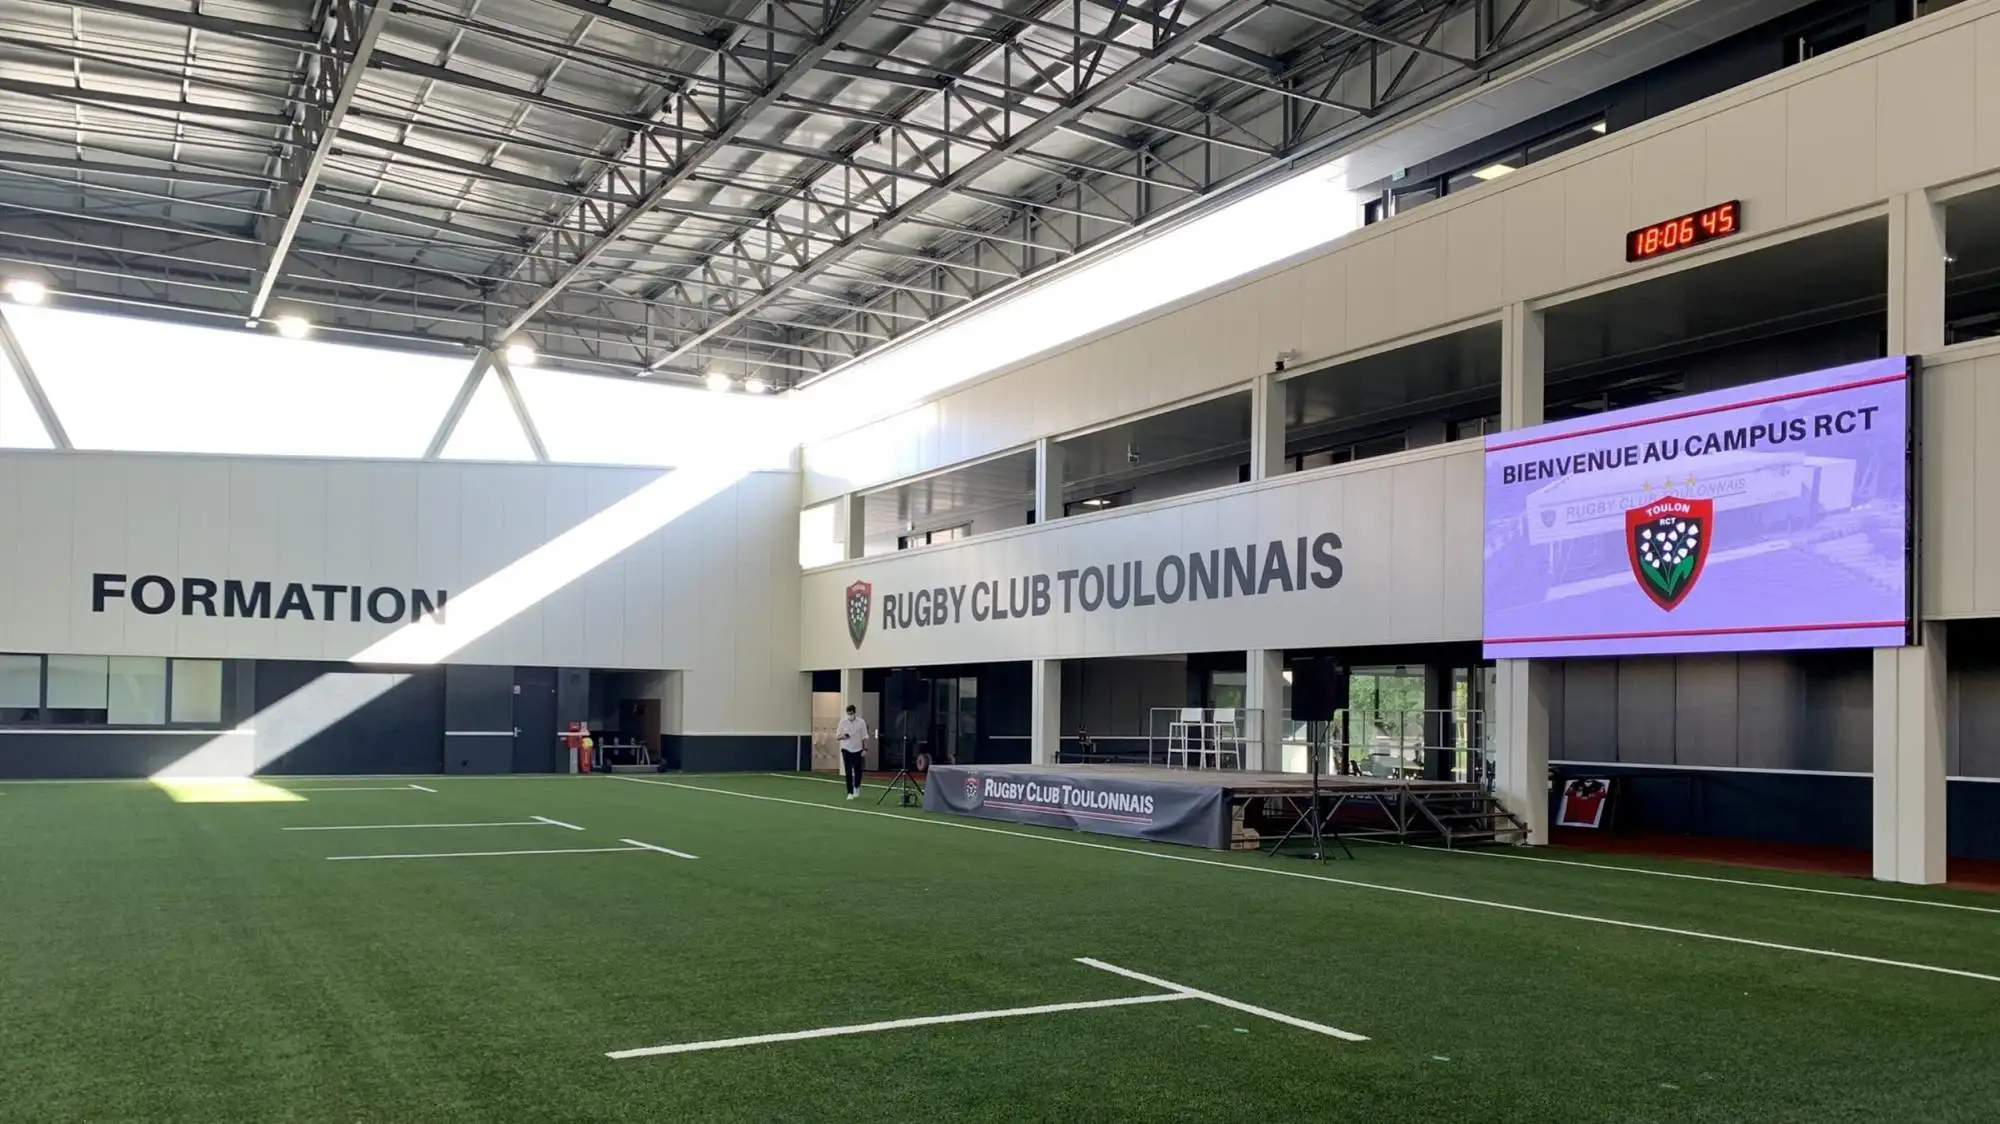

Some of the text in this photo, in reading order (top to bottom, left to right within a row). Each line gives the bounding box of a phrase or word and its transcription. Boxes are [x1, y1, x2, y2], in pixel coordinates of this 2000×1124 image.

[1637, 205, 1736, 255] 18:06 45
[1503, 406, 1879, 485] BIENVENUE AU CAMPUS RCT
[1566, 500, 1615, 519] RUGBY
[1645, 503, 1691, 517] TOULON
[1659, 517, 1677, 526] RCT
[92, 573, 448, 624] FORMATION
[883, 533, 1344, 630] RUGBY CLUB TOULONNAIS
[984, 779, 1155, 815] RUGBY CLUB TOULONNAIS
